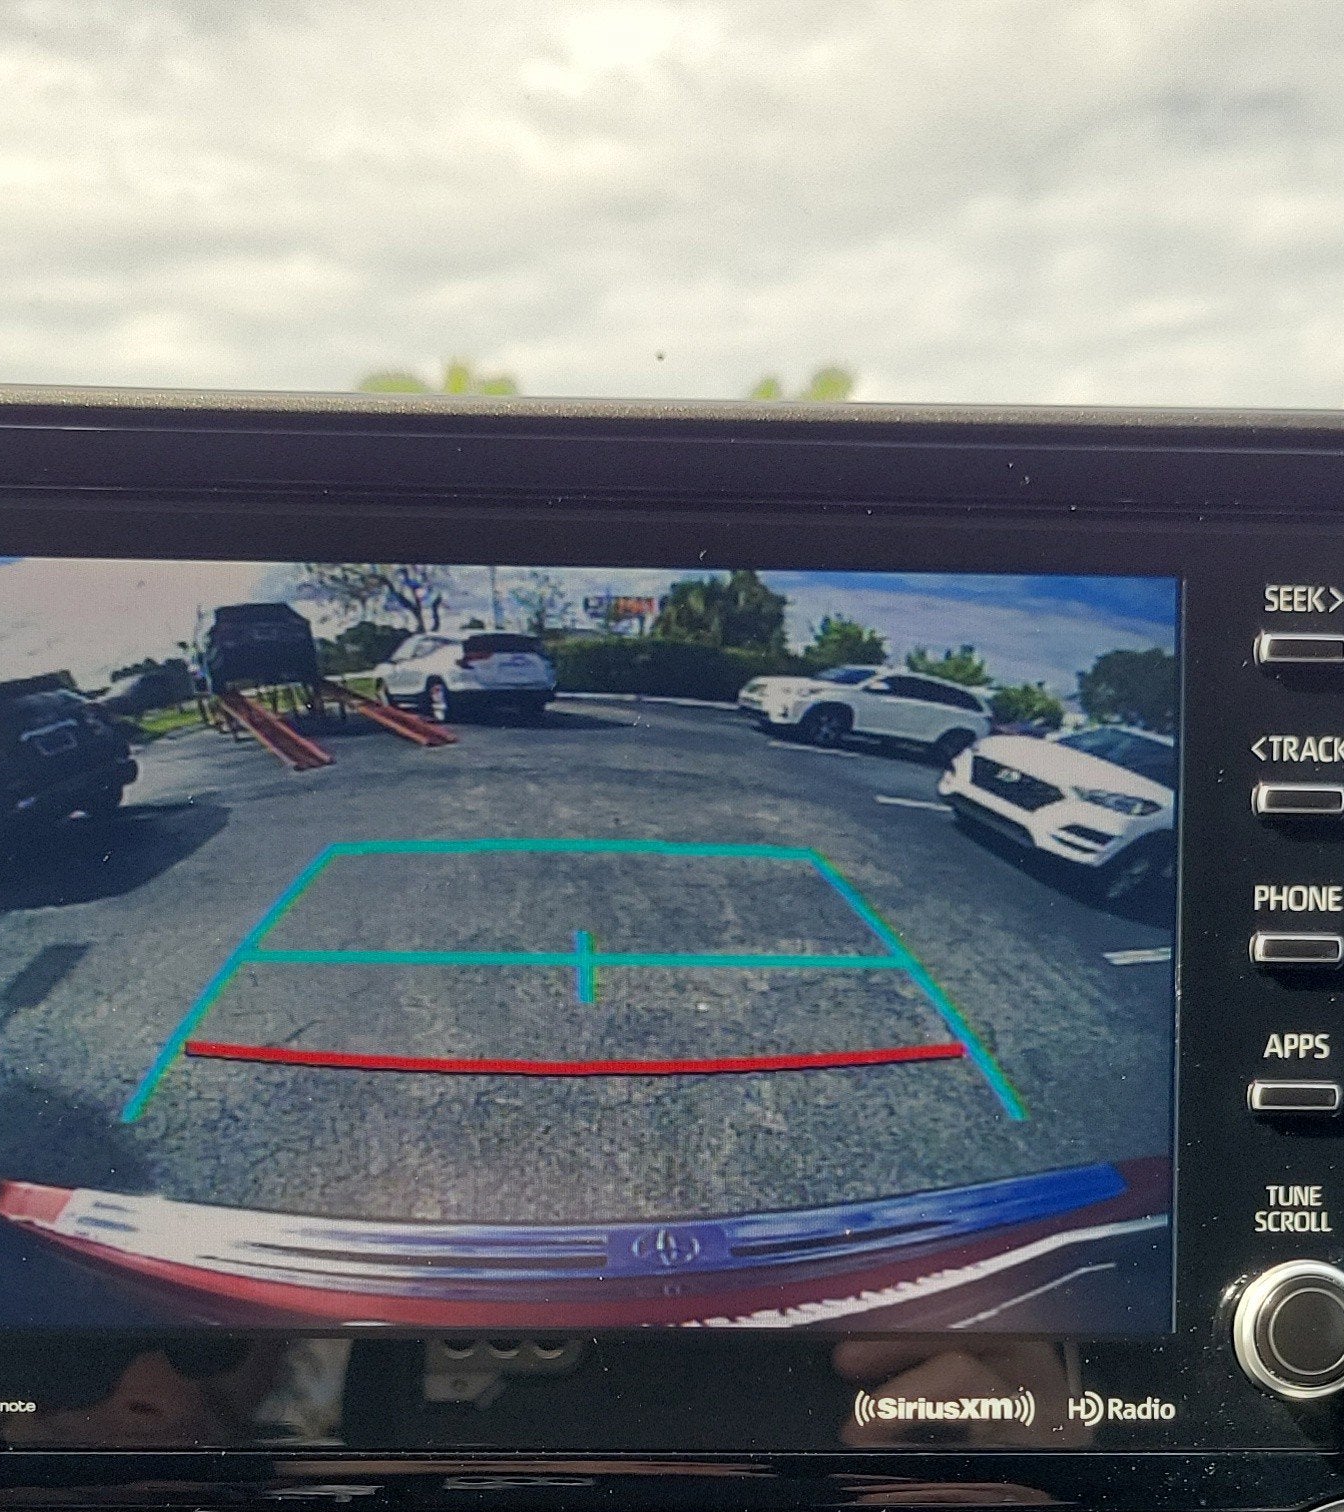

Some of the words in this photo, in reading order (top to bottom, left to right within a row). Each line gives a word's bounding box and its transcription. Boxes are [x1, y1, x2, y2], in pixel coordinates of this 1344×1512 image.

[1253, 885, 1344, 912] PHONE
[1262, 1033, 1330, 1059] APPS
[1266, 1185, 1323, 1207] TUNE
[1254, 1211, 1333, 1233] SCROLL
[1107, 1396, 1176, 1421] Radio
